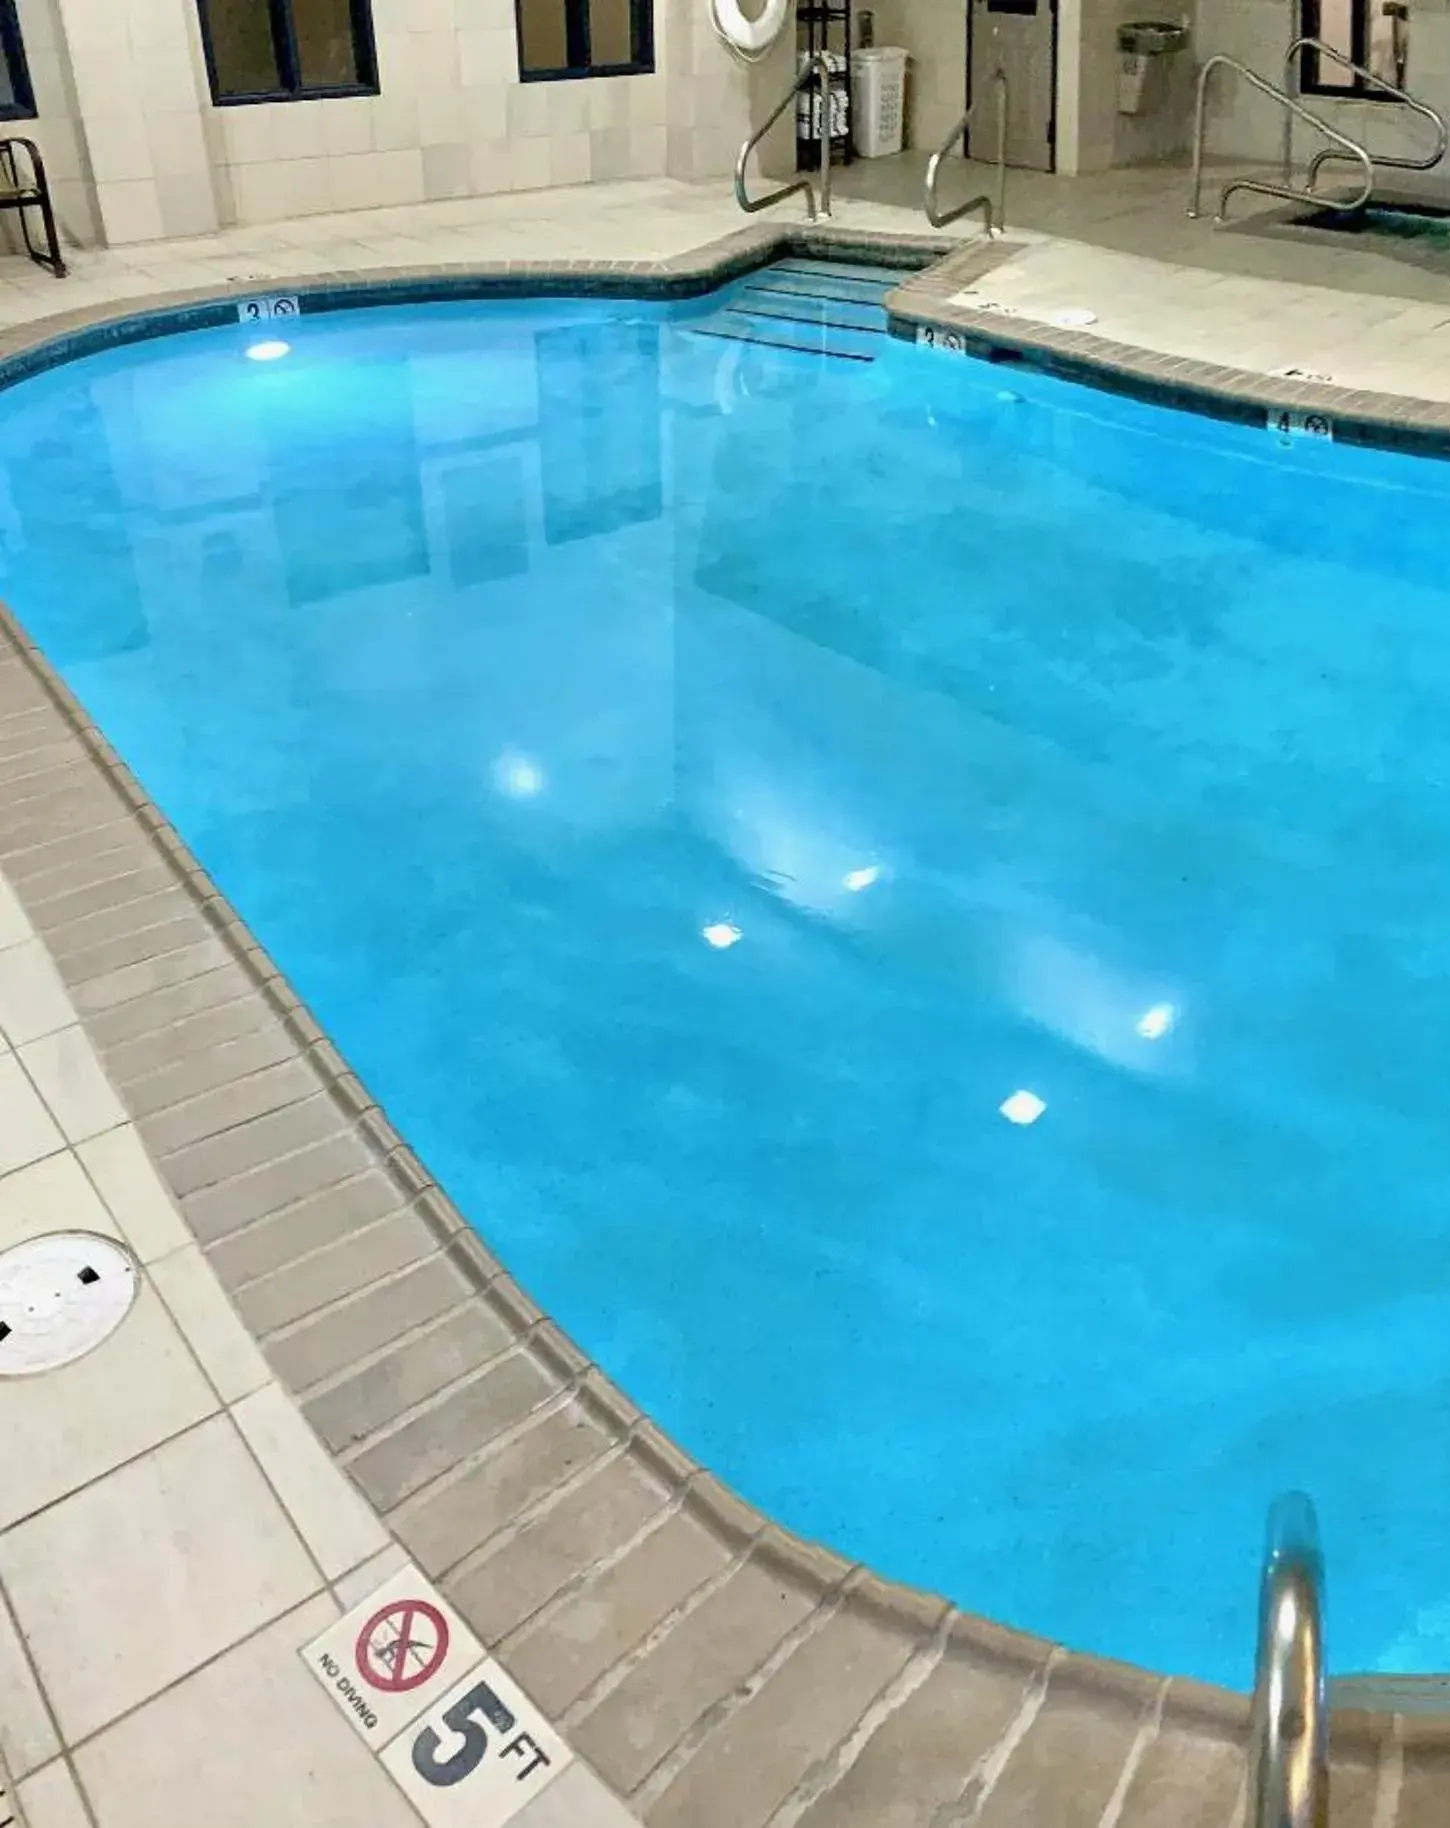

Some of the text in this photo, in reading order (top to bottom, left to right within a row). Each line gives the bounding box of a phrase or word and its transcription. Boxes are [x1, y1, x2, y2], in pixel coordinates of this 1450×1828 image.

[319, 1653, 378, 1729] NO DIVING
[411, 1680, 551, 1787] 5 FT
